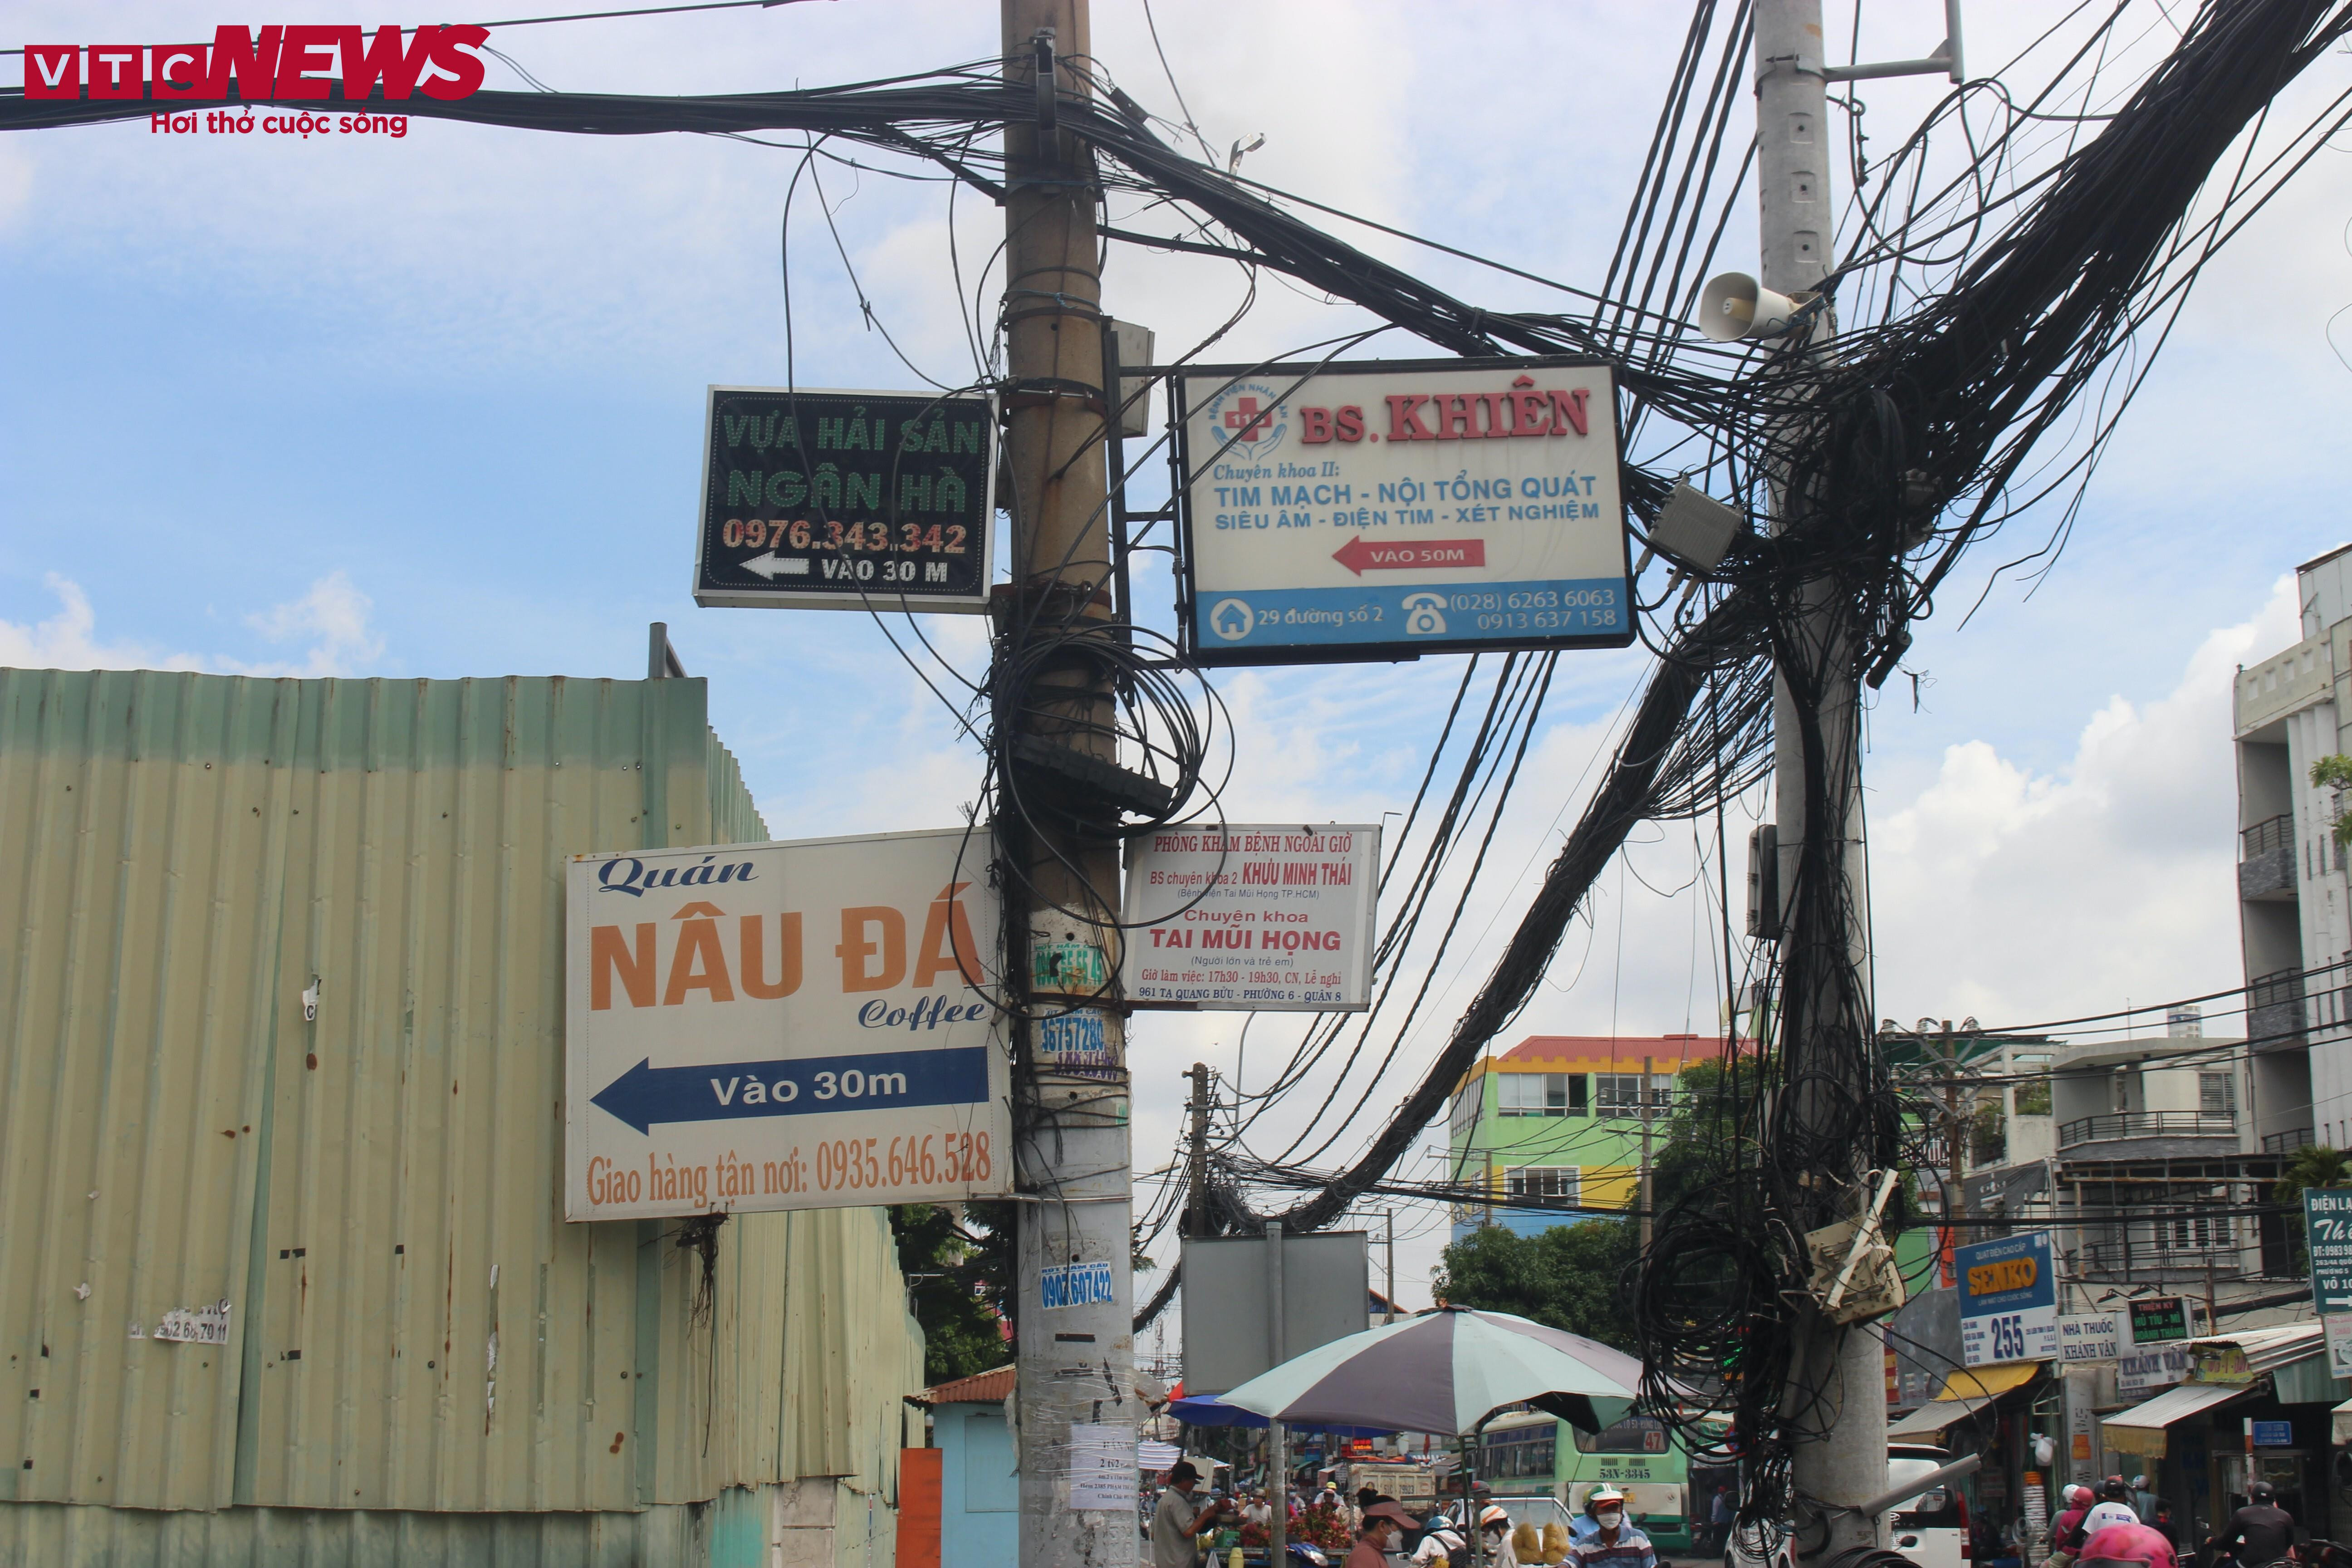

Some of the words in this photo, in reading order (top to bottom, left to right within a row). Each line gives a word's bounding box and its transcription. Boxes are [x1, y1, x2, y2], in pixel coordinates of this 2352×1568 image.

[724, 410, 798, 455] VỰA
[818, 406, 885, 451] HẢI
[900, 409, 979, 454] SẢN
[1214, 462, 1273, 481] Chuyên
[1278, 462, 1317, 479] khoa
[1321, 461, 1340, 478] II:
[727, 463, 880, 510] NGÂN
[901, 466, 965, 512] HÀ
[1214, 486, 1261, 508] TIM
[1272, 484, 1352, 510] MẠCH
[1379, 477, 1425, 508] NỘI
[1434, 470, 1511, 502] TỔNG
[1522, 470, 1596, 499] QUÁT
[1215, 510, 1269, 530] SIÊU
[1277, 508, 1311, 529] ÂM
[1333, 507, 1388, 529] ĐIỆN
[1396, 509, 1434, 525] TIM
[1456, 505, 1501, 523] XÉT
[1509, 500, 1599, 522] NGHIỆM
[722, 519, 966, 554] 0976.343.342
[1371, 545, 1416, 563] VÀO
[1421, 548, 1465, 563] 50M
[821, 555, 874, 581] VÀO
[883, 561, 915, 581] 30
[925, 562, 947, 583] M
[1450, 593, 1502, 612] (028)
[1508, 591, 1558, 608] 6263
[1566, 589, 1616, 607] 6063
[1258, 610, 1280, 625] 29
[1285, 608, 1343, 627] đường
[1348, 603, 1369, 623] số
[1373, 606, 1384, 622] 2
[1478, 613, 1528, 630] 0913
[1535, 611, 1573, 629] 637
[1580, 609, 1617, 627] 158
[1154, 832, 1198, 852] PHÒNG
[1245, 831, 1281, 856] BỆNH
[1284, 832, 1325, 852] NGOÀI
[1329, 831, 1352, 853] GIỜ
[598, 855, 759, 898] Quán
[1150, 872, 1164, 884] BS
[1167, 872, 1202, 888] chuyên
[1206, 872, 1228, 884] khoa
[1232, 872, 1238, 884] 2
[1283, 863, 1317, 885] MINH
[1322, 857, 1352, 885] THÁI
[1178, 889, 1202, 898] (Bệnh
[1256, 890, 1278, 900] Họng
[1282, 890, 1319, 899] TP.HCM)
[1184, 909, 1256, 924] Chuyên
[1264, 910, 1308, 922] khoa
[591, 901, 803, 1011] NÂU
[835, 882, 985, 994] ĐÁ
[1150, 929, 1192, 948] TAI
[1202, 924, 1252, 949] MŨI
[1261, 931, 1341, 956] HỌNG
[1191, 956, 1223, 966] (Người
[1259, 957, 1271, 965] trẻ
[1275, 958, 1293, 966] em)
[1142, 969, 1158, 980] Giờ
[1161, 970, 1178, 981] làm
[1182, 970, 1204, 984] việc:
[1208, 971, 1238, 982] 17h30
[1249, 971, 1281, 984] 19h30,
[1285, 972, 1301, 985] CN,
[1305, 970, 1316, 984] Lễ
[1139, 987, 1155, 996] 961
[1160, 989, 1172, 1000] TẠ
[1176, 989, 1210, 1000] QUANG
[1213, 986, 1234, 998] BỬU
[1243, 988, 1284, 999] PHƯỜNG
[1288, 991, 1294, 999] 6
[1304, 990, 1332, 1003] QUẬN
[1335, 992, 1341, 1001] 8
[858, 995, 988, 1031] Coffee
[710, 1074, 799, 1106] Vào
[813, 1069, 906, 1100] 30m
[588, 1155, 641, 1205] Giao
[649, 1151, 707, 1208] hàng
[715, 1150, 755, 1206] tận
[763, 1146, 808, 1194] nơi:
[817, 1131, 990, 1191] 0935.646.528
[2311, 1195, 2336, 1214] ĐIỆN
[1968, 1257, 2037, 1296] SENKO
[2322, 1276, 2338, 1289] VÔ
[201, 1323, 213, 1339] 70
[218, 1324, 226, 1341] 11
[1991, 1315, 2024, 1358] 255
[2063, 1321, 2081, 1336] NHÀ
[2083, 1317, 2113, 1334] THUỐC
[2063, 1340, 2097, 1359] KHÁNH
[2098, 1339, 2117, 1357] VÂN
[1645, 1432, 1661, 1450] 47
[1599, 1469, 1650, 1479] 53N-3345
